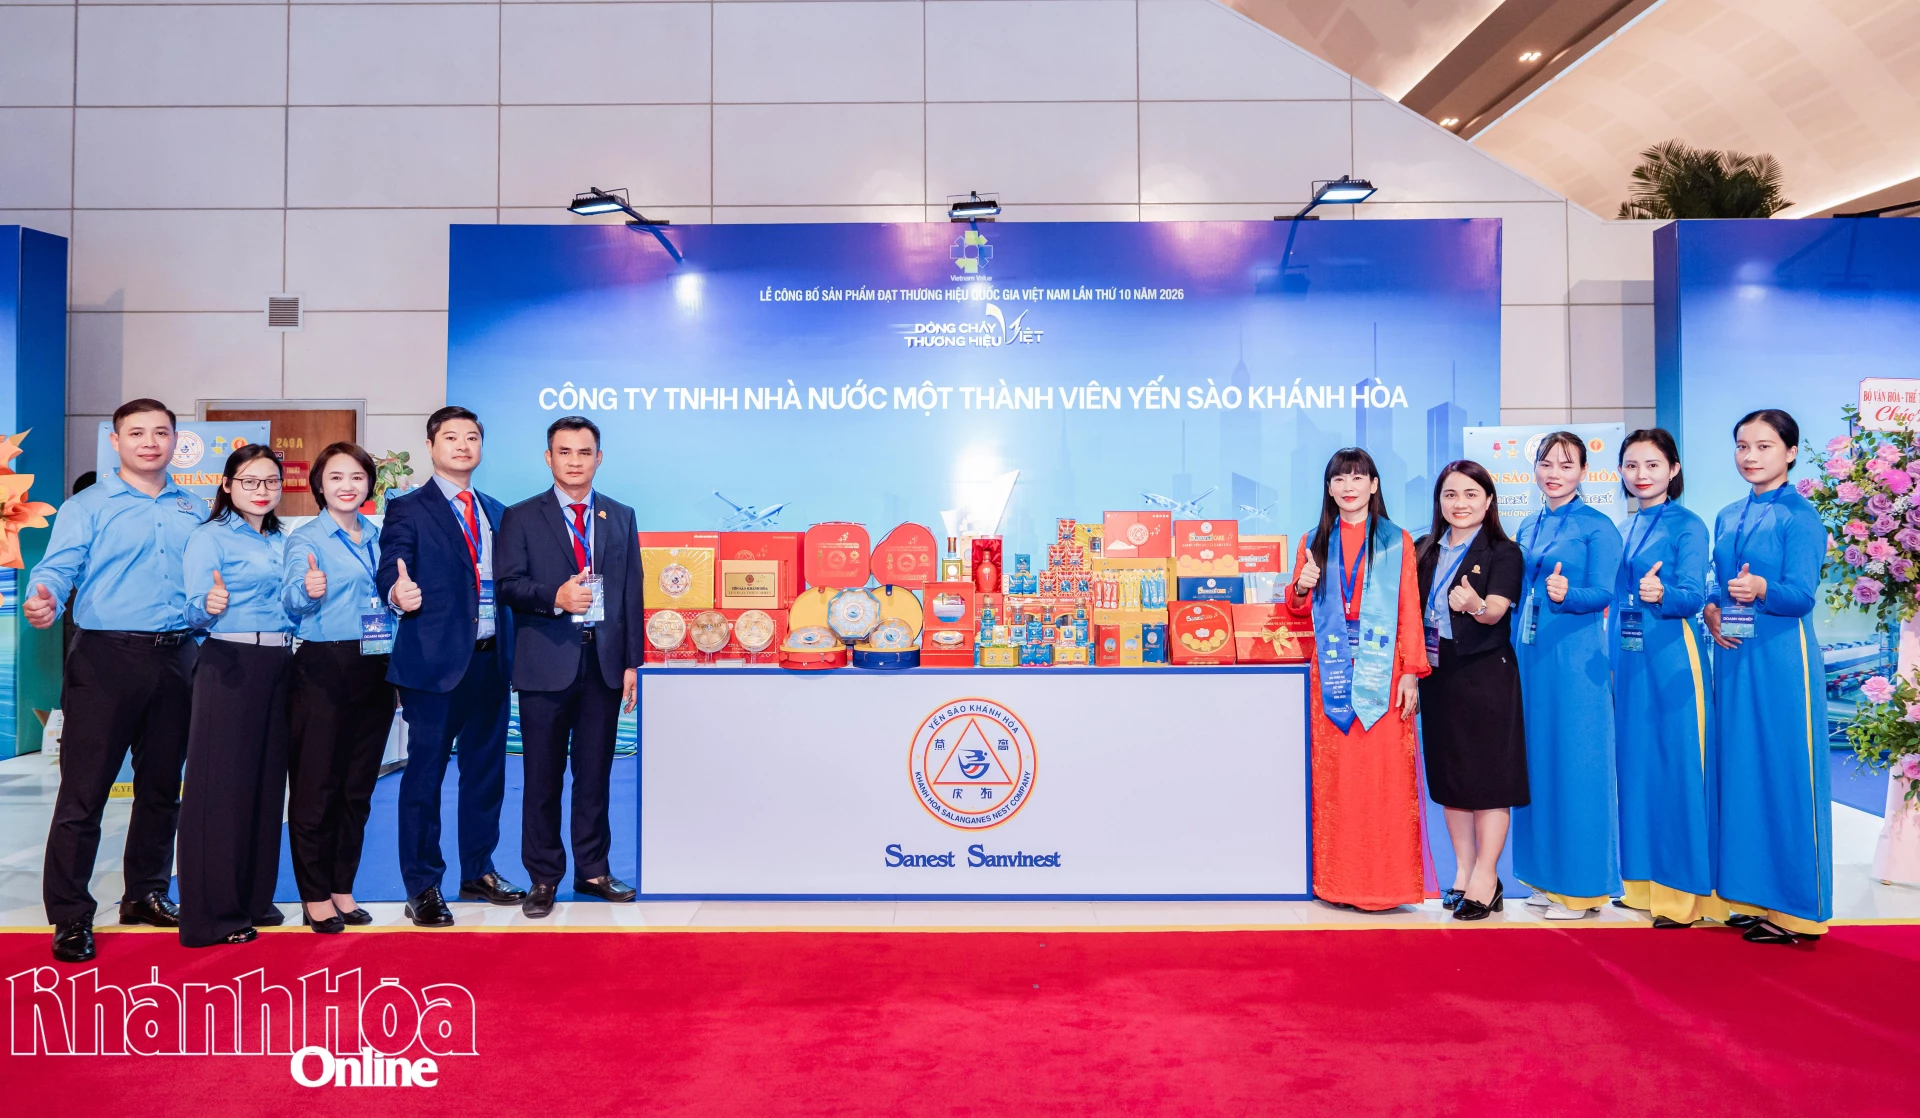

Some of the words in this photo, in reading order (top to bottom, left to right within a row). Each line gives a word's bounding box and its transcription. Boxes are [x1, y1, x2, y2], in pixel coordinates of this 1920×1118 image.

[760, 286, 773, 302] LỄ
[775, 287, 803, 302] CÔNG
[805, 286, 820, 302] BỐ
[822, 287, 843, 301] SẢN
[845, 285, 875, 301] PHẨM
[877, 289, 898, 303] ĐẠT
[900, 288, 943, 301] THƯƠNG
[945, 287, 969, 302] HIỆU
[971, 285, 1000, 303] QUỐC
[1003, 289, 1020, 300] GIA
[1022, 287, 1044, 302] VIỆT
[1047, 289, 1070, 300] NAM
[1073, 285, 1093, 300] LẦN
[1095, 286, 1117, 300] THỨ
[1119, 289, 1131, 300] 10
[1134, 287, 1157, 300] NĂM
[1160, 288, 1184, 300] 2026
[904, 335, 966, 348] THƯƠNG
[539, 381, 618, 410] CÔNG
[624, 387, 658, 410] TY
[664, 387, 738, 410] TNHH
[744, 379, 802, 410] NHÀ
[808, 379, 887, 410] NƯỚC
[893, 381, 953, 416] MỘT
[959, 379, 1053, 410] THÀNH
[1059, 380, 1121, 409] VIÊN
[1128, 375, 1181, 409] YẾN
[1186, 378, 1242, 410] SÀO
[1248, 378, 1345, 409] KHÁNH
[1351, 378, 1408, 409] HÒA
[1502, 470, 1530, 483] SÀO
[1587, 469, 1620, 482] HÒA
[928, 714, 946, 730] YẾN
[947, 705, 966, 717] SÀO
[969, 704, 1002, 719] KHÁNH
[1002, 716, 1019, 734] HÒA
[914, 771, 930, 799] KHANH
[927, 796, 941, 812] HOA
[941, 808, 992, 824] SALANGANES
[991, 804, 1011, 820] NEST
[1009, 770, 1031, 806] COMPANY
[885, 844, 956, 868] Sanest
[967, 844, 1062, 868] Sanvinest
